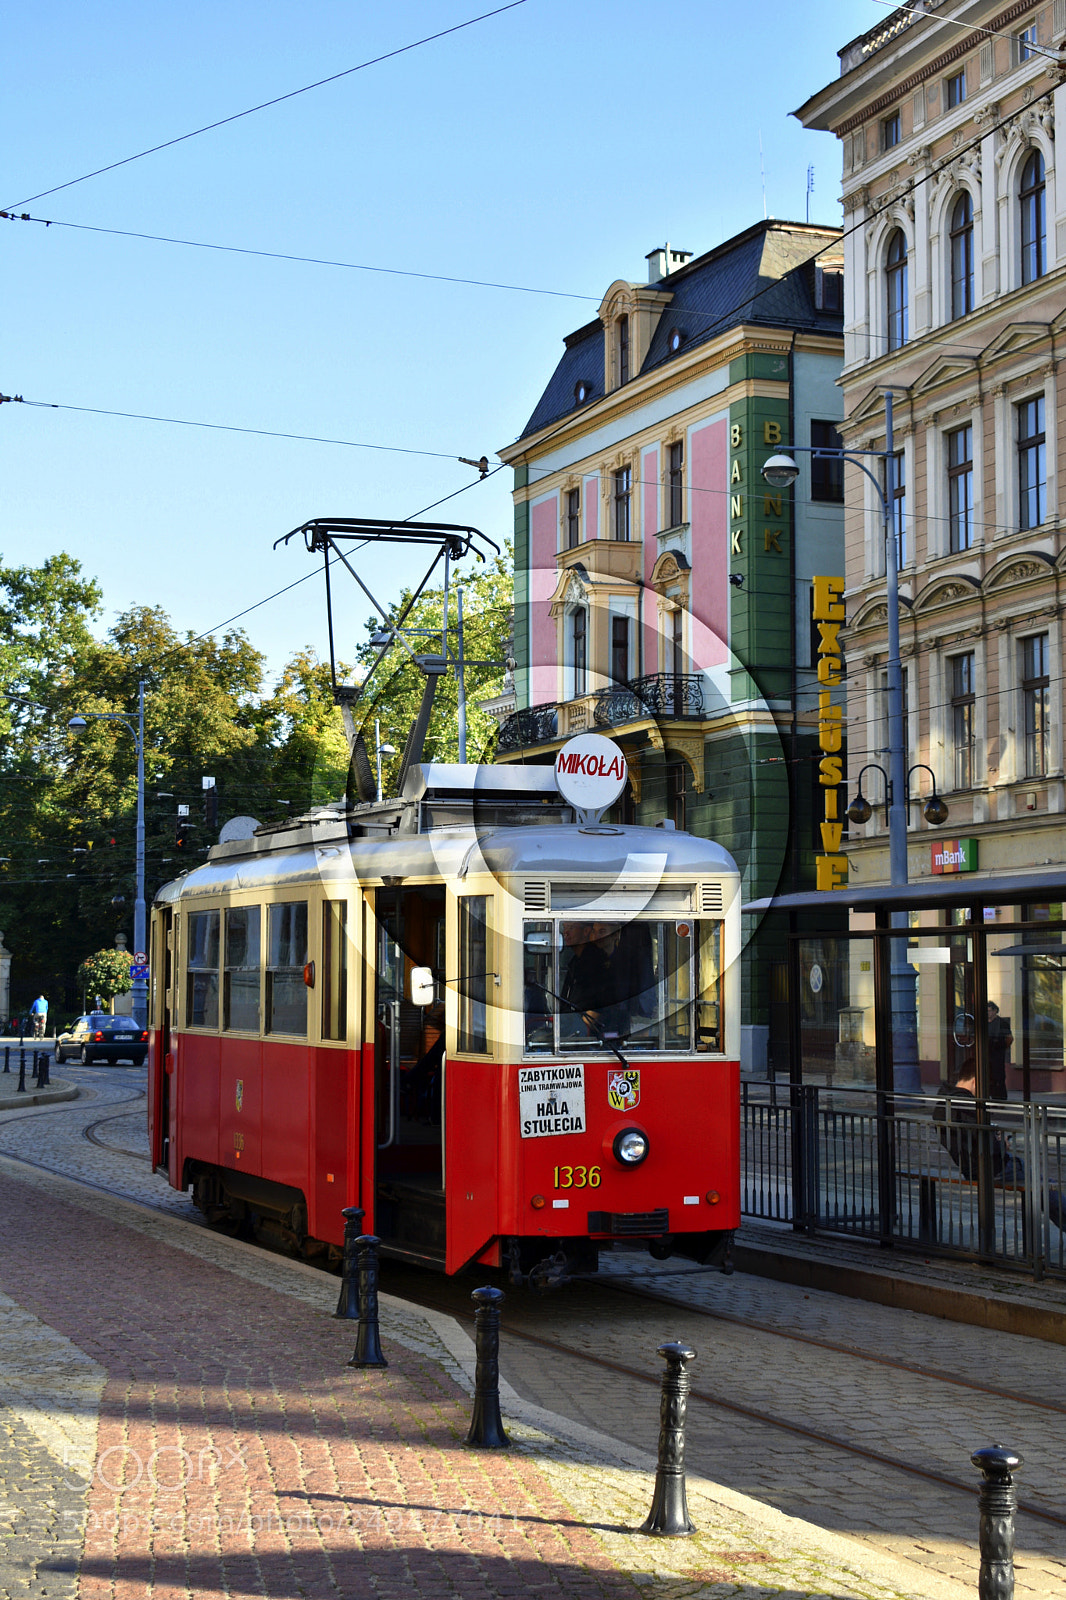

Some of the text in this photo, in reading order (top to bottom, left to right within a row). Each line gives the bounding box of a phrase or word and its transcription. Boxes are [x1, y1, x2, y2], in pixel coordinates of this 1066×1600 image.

[731, 424, 743, 555] BANK
[764, 421, 783, 553] BNK
[812, 575, 848, 891] EXCLUSIVE
[934, 847, 967, 866] mBank
[520, 1067, 582, 1083] ZABYTKOWA
[520, 1080, 583, 1093] LINIA TRAMWAJOWA
[536, 1101, 569, 1117] HALA
[523, 1117, 583, 1135] STULECIA
[553, 1165, 602, 1189] 1336
